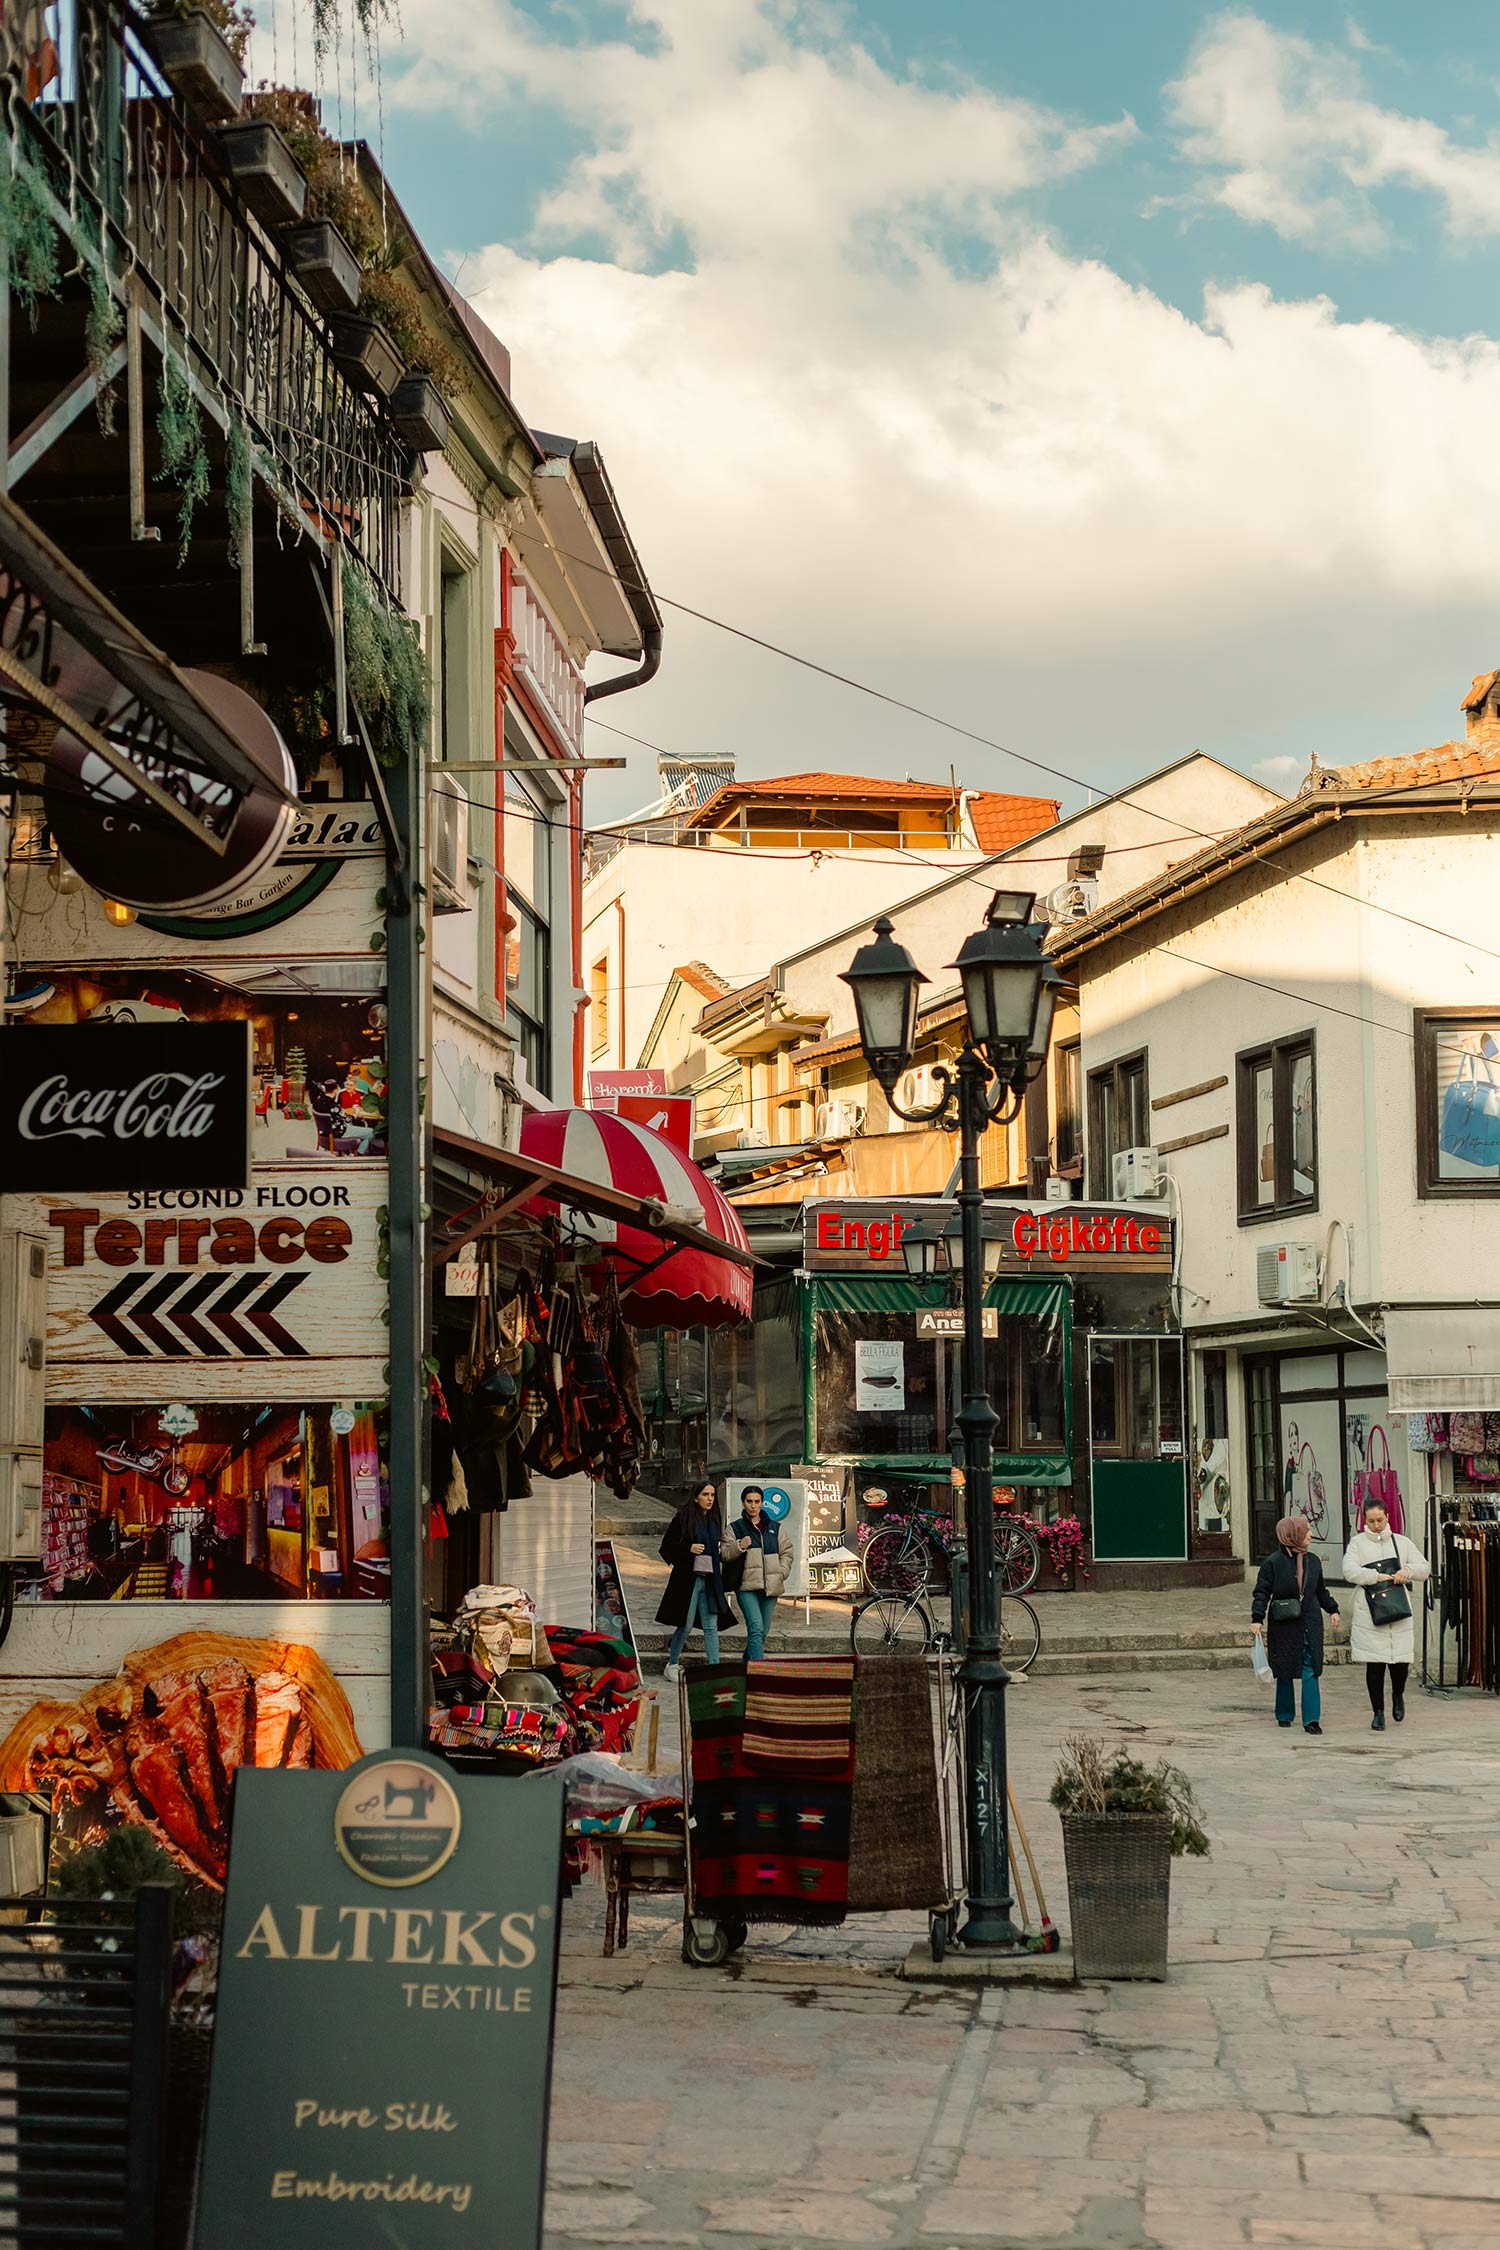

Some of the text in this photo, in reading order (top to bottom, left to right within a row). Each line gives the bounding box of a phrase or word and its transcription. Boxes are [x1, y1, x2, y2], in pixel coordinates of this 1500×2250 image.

[236, 898, 255, 910] Bar
[259, 874, 293, 900] Garden
[18, 1072, 226, 1140] Coca-Cola
[127, 1185, 351, 1210] SECOND FLOOR
[49, 1208, 352, 1266] Terrace
[816, 1213, 1162, 1262] Engi Çiğköfte
[808, 1535, 828, 1546] DER
[235, 1903, 537, 1969] ALTEKS
[401, 1983, 532, 2013] TEXTILE
[295, 2100, 459, 2132] Pure Silk
[271, 2170, 473, 2212] Embroidery
